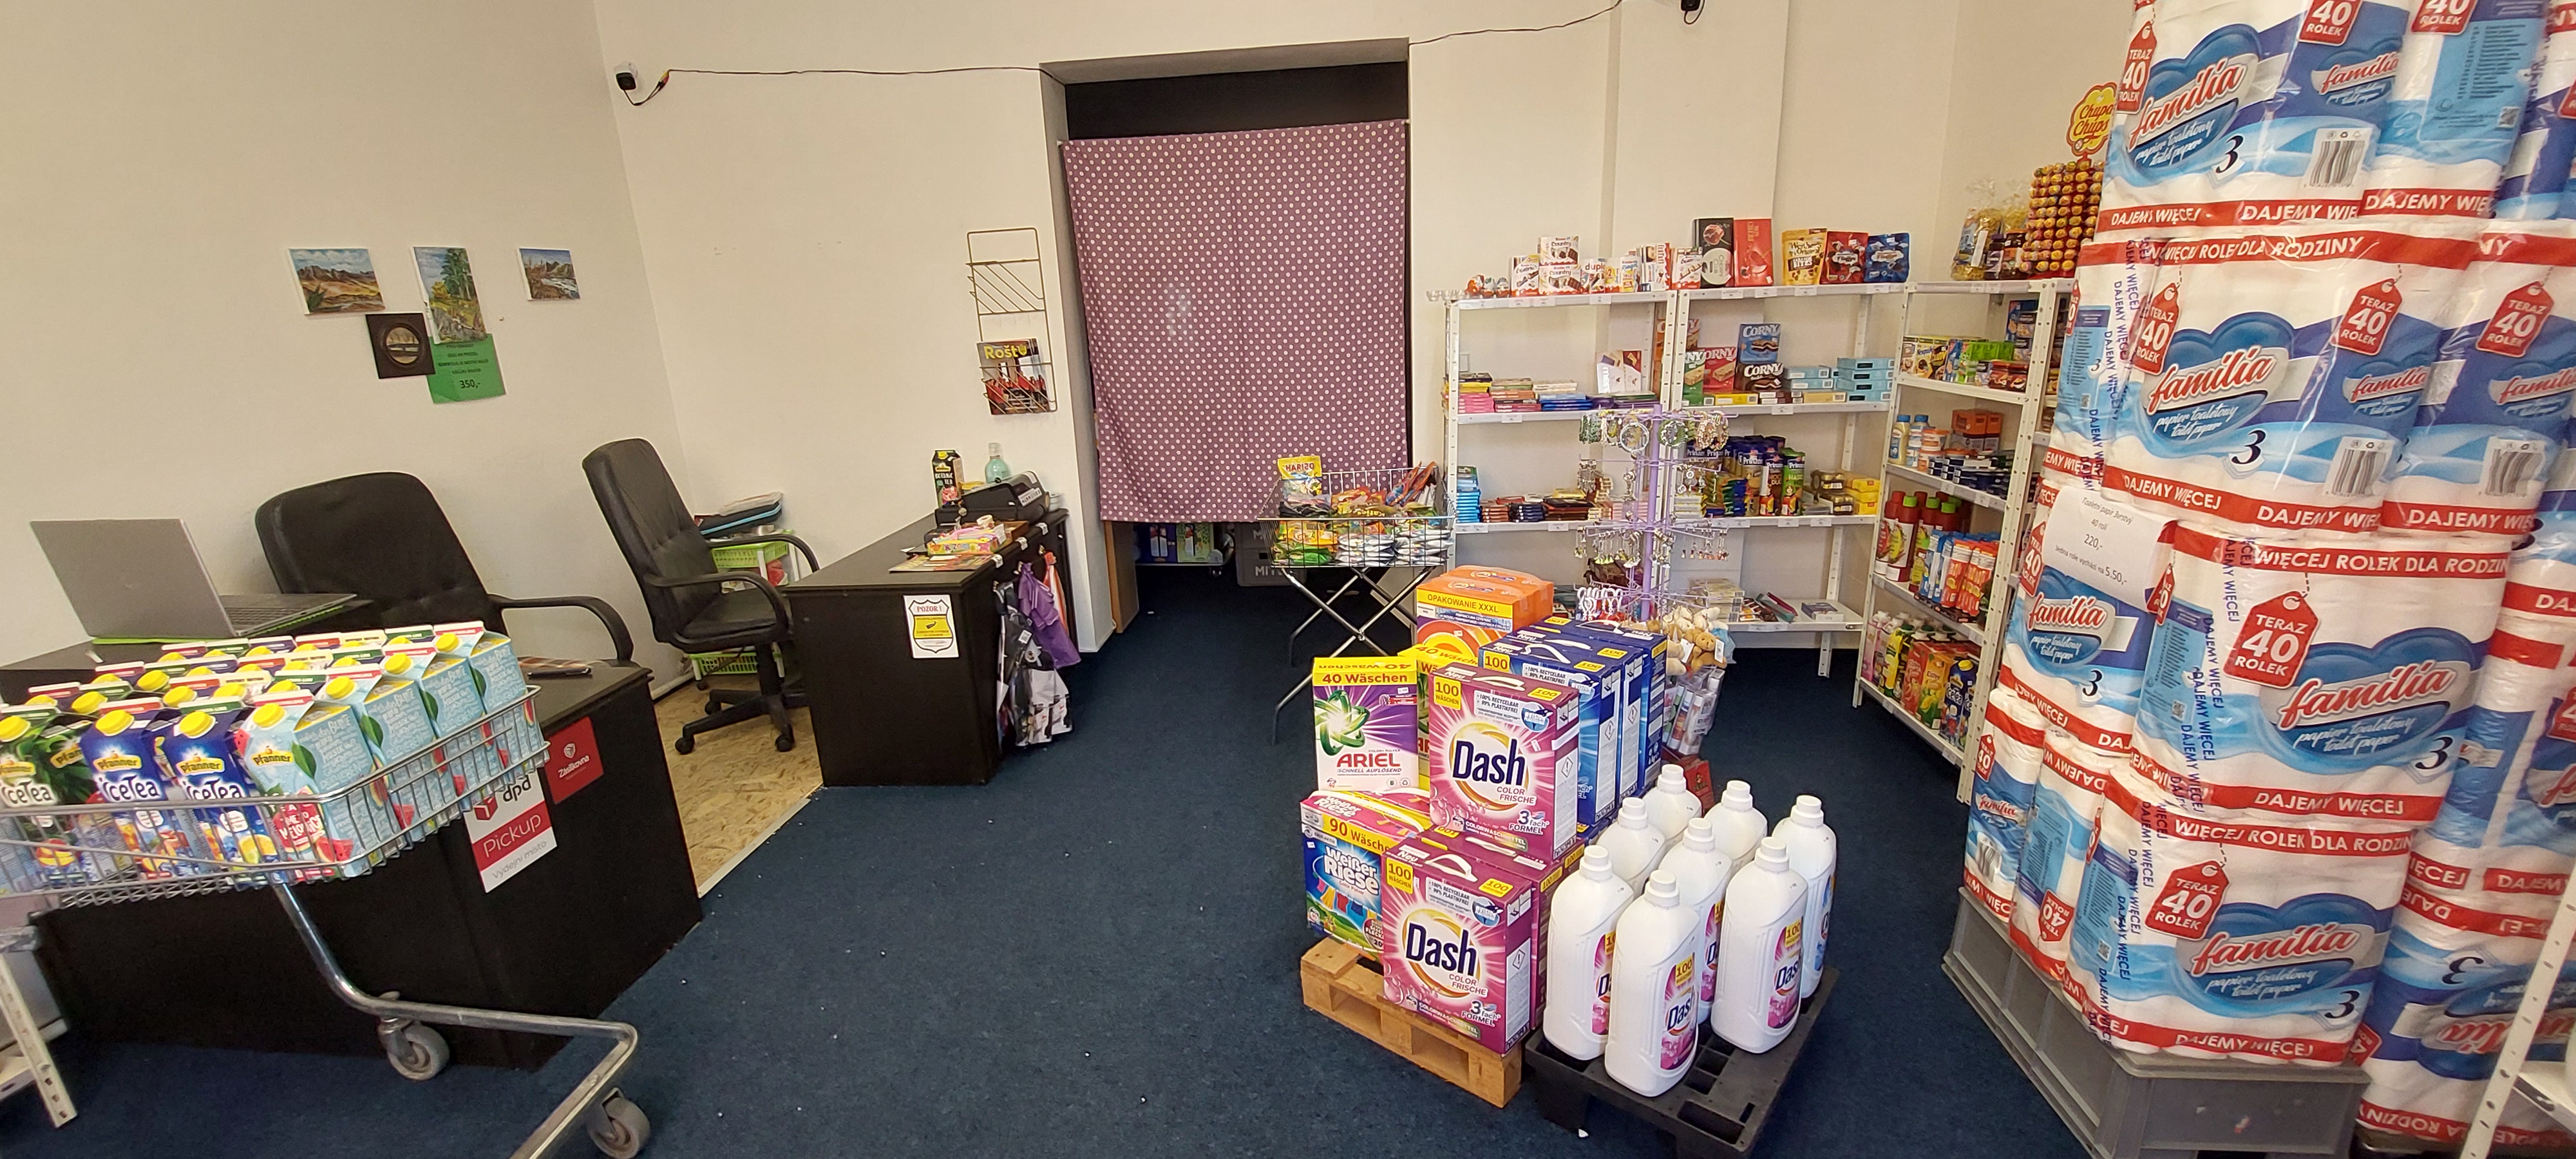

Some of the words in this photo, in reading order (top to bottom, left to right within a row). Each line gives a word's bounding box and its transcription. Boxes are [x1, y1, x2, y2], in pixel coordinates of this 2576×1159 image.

[2311, 1, 2352, 26] 40
[2420, 14, 2463, 26] ROLEK
[2306, 23, 2344, 37] ROLEK
[2130, 50, 2151, 60] TERAZ
[2124, 62, 2145, 91] 40
[2320, 52, 2401, 94] familia
[2079, 104, 2114, 120] Chupa
[2130, 58, 2246, 149] familia
[2073, 119, 2110, 137] Chups
[2216, 135, 2244, 173] 3
[2365, 194, 2454, 210] DAJEMY
[2239, 204, 2323, 221] DAJEMY
[2361, 295, 2395, 313] TERAZ
[2508, 299, 2547, 315] TERAZ
[2150, 306, 2174, 323] TERAZ
[2348, 308, 2386, 335] 40
[1743, 325, 1781, 337] CORNY
[2495, 312, 2535, 337] 40
[2141, 321, 2171, 350] 40
[2340, 328, 2376, 346] ROLEK
[2486, 333, 2526, 347] ROLEK
[2136, 348, 2159, 364] ROLEK
[1744, 363, 1783, 377] CORNY
[460, 379, 480, 389] 350,-
[2147, 347, 2275, 413] familia
[2351, 367, 2428, 402] familia
[2231, 429, 2266, 464] 3
[1285, 463, 1314, 471] HARIBO
[2125, 475, 2174, 498] DAJEMY
[2175, 485, 2222, 510] WIĘCEJ
[2257, 505, 2340, 527] DAJEMY
[2409, 509, 2503, 529] DAJEMY
[2084, 534, 2103, 551] 220,-
[2025, 550, 2041, 577] 40
[2254, 549, 2331, 569] WIĘCEJ
[2336, 555, 2401, 572] ROLEK
[2405, 556, 2439, 572] DLA
[1428, 594, 1476, 608] OPAKOWANIE
[1479, 603, 1499, 612] XXXL
[2224, 580, 2240, 622] WIĘCEJ
[2028, 592, 2107, 630] familia
[2255, 614, 2309, 635] TERAZ
[2240, 629, 2300, 663] 40
[1485, 655, 1508, 670] 100
[2234, 655, 2289, 677] ROLEK
[1322, 674, 1341, 683] 40
[1345, 673, 1407, 683] Wäschen
[2082, 670, 2103, 696] 3
[1435, 682, 1459, 697] 100
[2208, 668, 2224, 710] WIĘCEJ
[2279, 661, 2452, 729] familia
[1435, 694, 1459, 705] WÄSCHEN
[1491, 702, 1518, 713] PLASTIKFREI
[1492, 697, 1519, 708] RECYCELBAR
[2197, 719, 2216, 761] WIĘCEJ
[253, 755, 291, 766] Pfanner
[1336, 753, 1401, 767] ARIEL
[1452, 737, 1525, 786] Dash
[2414, 735, 2453, 770] 3
[97, 759, 137, 769] Pfanner
[180, 762, 220, 773] Pfanner
[558, 755, 590, 778] Zásilkovna
[502, 776, 531, 803] dpd
[1497, 787, 1525, 795] COLOR
[1499, 794, 1535, 804] FRISCHE
[1314, 798, 1357, 818] Riese
[2254, 791, 2331, 812] DAJEMY
[2338, 796, 2404, 815] WIĘCEJ
[1329, 818, 1348, 836] 90
[1518, 811, 1530, 825] 3
[483, 815, 542, 858] Pickup
[1509, 824, 1543, 834] FORMEL
[2174, 820, 2247, 842] WIĘCEJ
[2247, 828, 2306, 849] ROLEK
[2310, 835, 2347, 851] DLA
[1325, 846, 1378, 877] Weißer
[1397, 850, 1418, 862] Neu
[1324, 855, 1379, 895] Riese
[1388, 863, 1412, 880] 100
[2142, 848, 2154, 888] WIĘCEJ
[1388, 875, 1412, 889] WÄSCHEN
[1431, 881, 1443, 890] 100%
[1443, 885, 1470, 900] RECYCELBAR
[1486, 880, 1510, 890] 100
[2175, 878, 2220, 895] TERAZ
[1443, 892, 1469, 906] PLASTIKFREI
[2161, 890, 2212, 919] 40
[2128, 894, 2141, 935] WIĘCEJ
[2154, 911, 2202, 930] ROLEK
[1785, 921, 1802, 939] 100
[1406, 921, 1477, 976] Dash
[2191, 924, 2359, 975] familia
[1676, 959, 1693, 976] 100
[2116, 943, 2131, 981] WIĘCEJ
[2442, 956, 2485, 985] 3
[1448, 974, 1477, 986] COLOR
[1452, 981, 1486, 996] FRISCHE
[2098, 967, 2112, 1011] DAJEMY
[1470, 1001, 1482, 1013] 3
[2324, 990, 2360, 1019] 3
[1461, 1012, 1495, 1026] FORMEL
[2175, 1034, 2248, 1051] DAJEMY
[2253, 1039, 2313, 1057] WIĘCEJ
